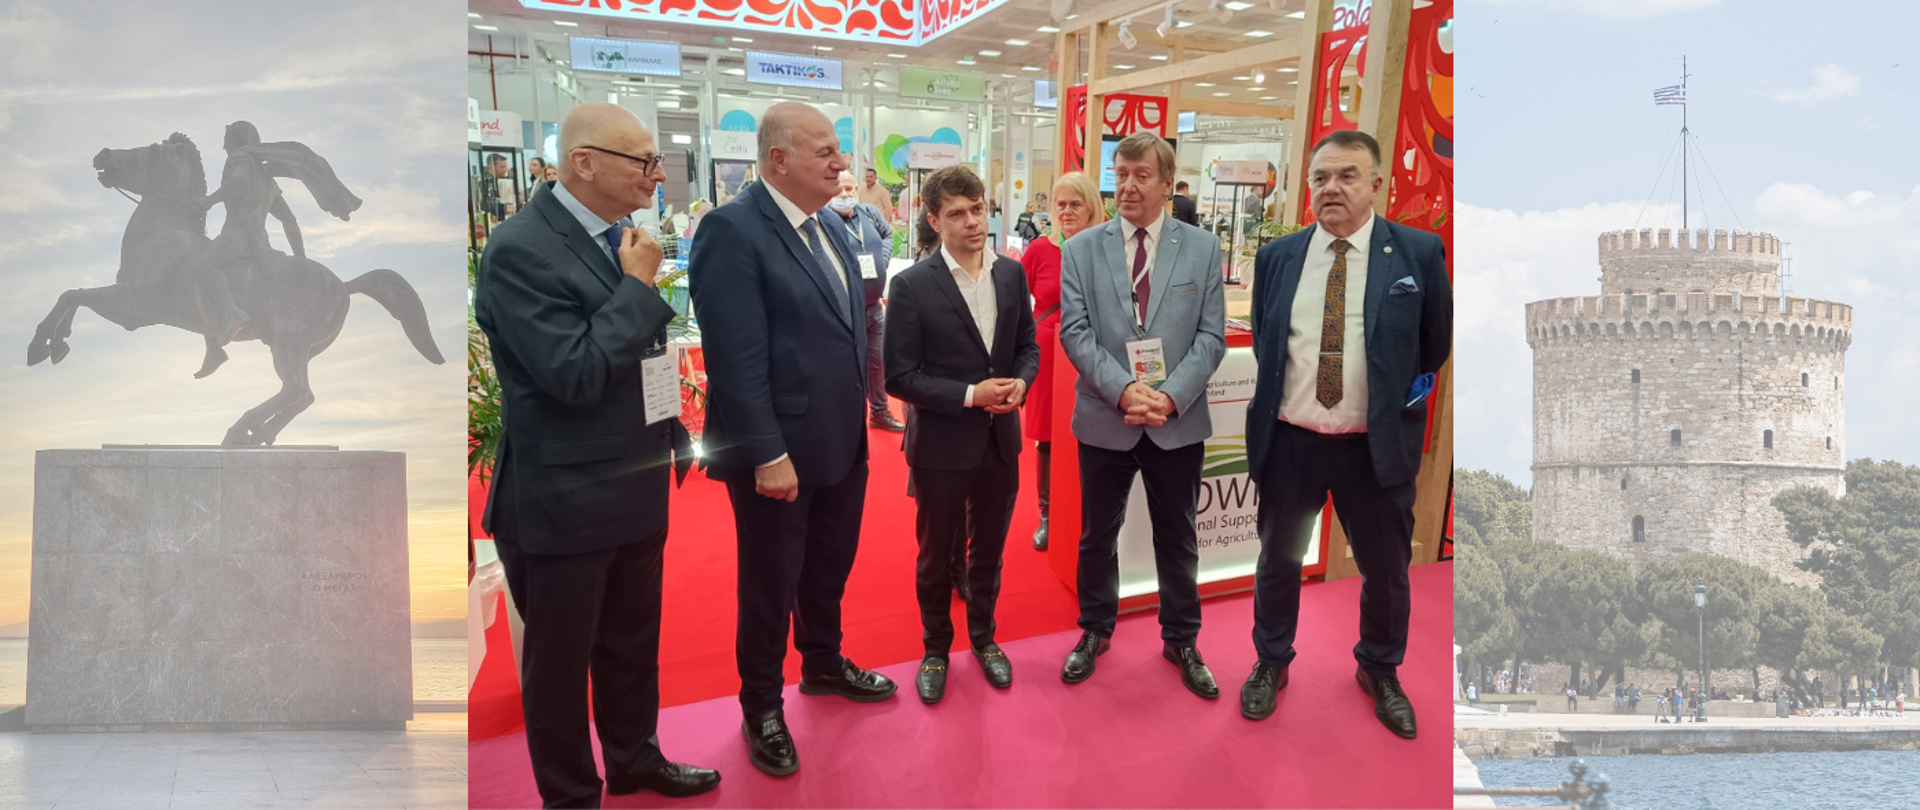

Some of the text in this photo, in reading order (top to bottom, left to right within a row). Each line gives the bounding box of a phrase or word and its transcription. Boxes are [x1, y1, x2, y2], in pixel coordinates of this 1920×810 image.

[759, 62, 825, 78] TAKTIKOS
[1238, 378, 1250, 386] and
[1198, 537, 1213, 548] for
